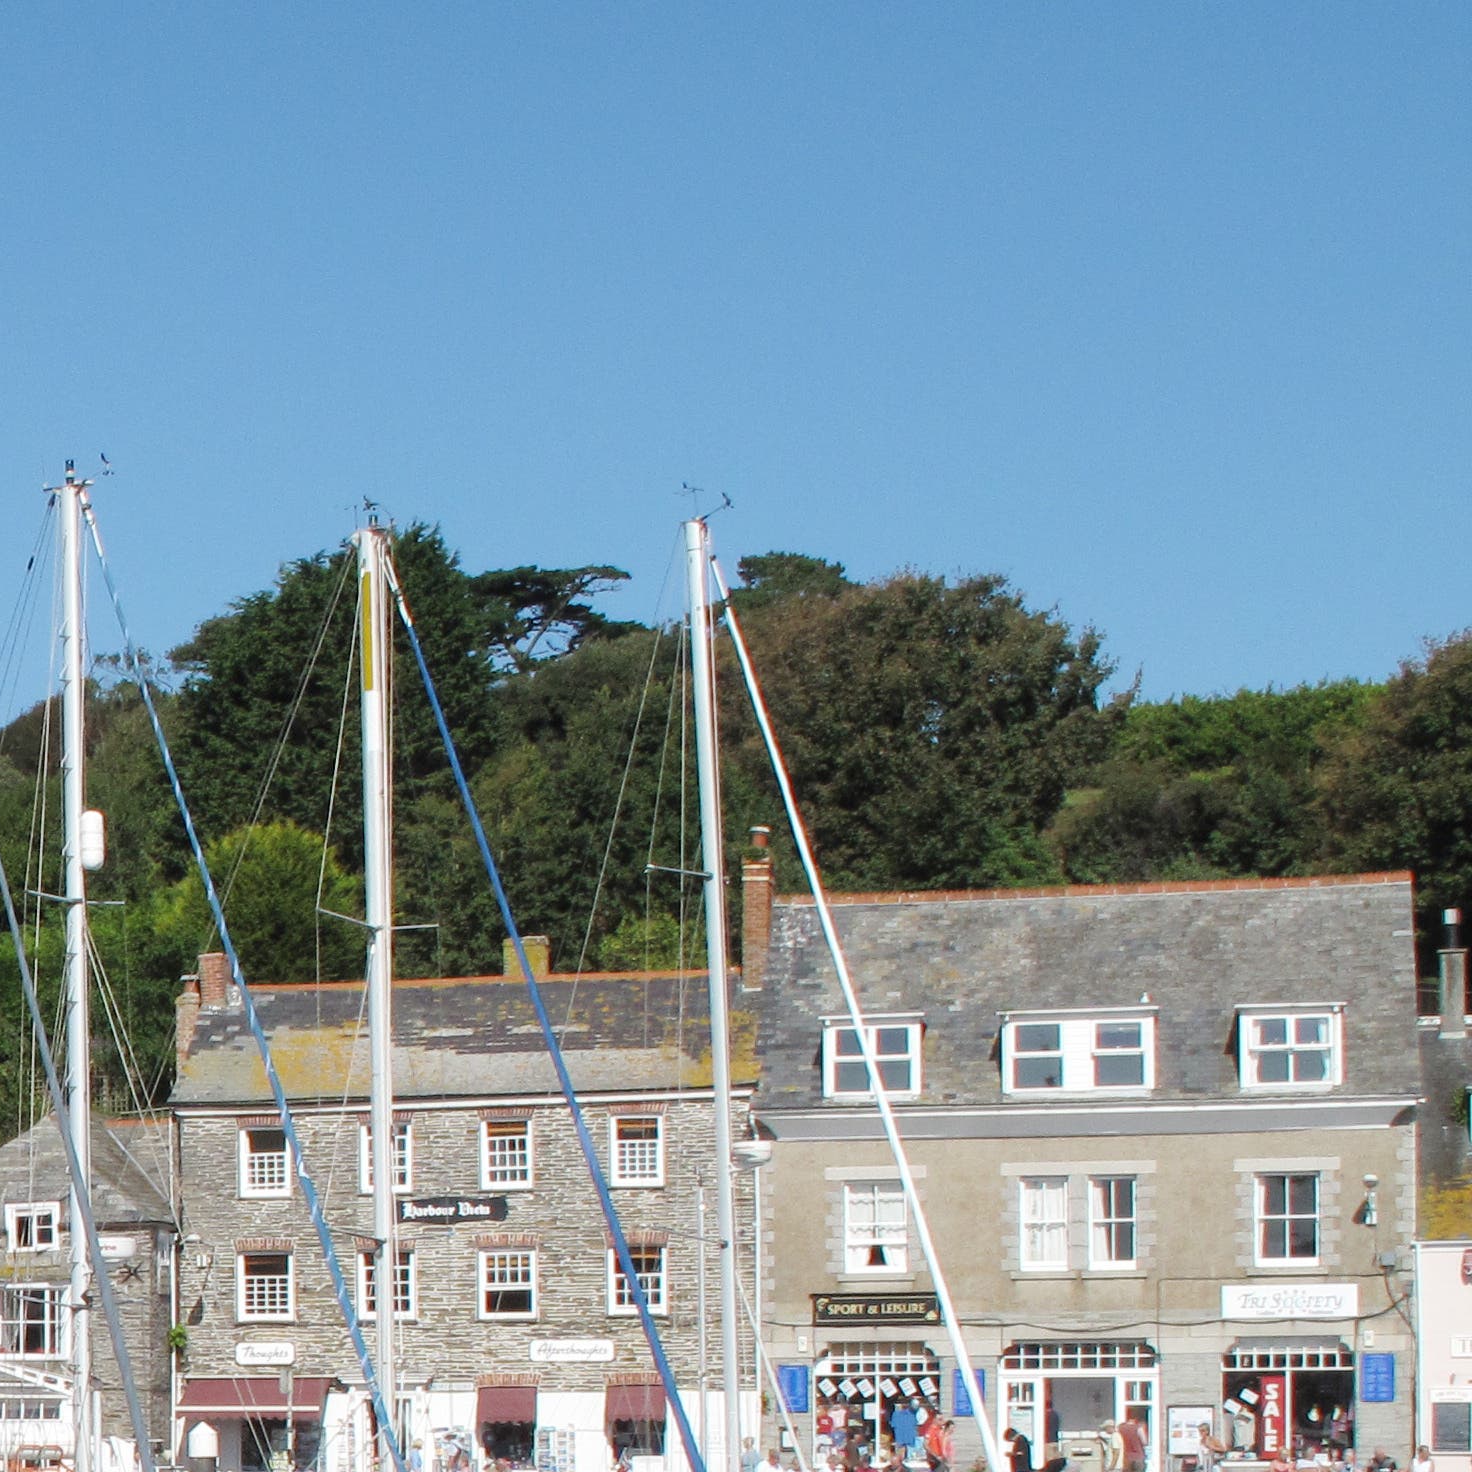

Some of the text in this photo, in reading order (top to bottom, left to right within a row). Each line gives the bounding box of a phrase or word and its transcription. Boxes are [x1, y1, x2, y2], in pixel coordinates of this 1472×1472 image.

[402, 1202, 455, 1219] Harbour
[827, 1304, 865, 1315] SPORT
[880, 1303, 926, 1314] LEISURE
[241, 1346, 289, 1361] Thoughts
[536, 1342, 608, 1359] Afterthoughts
[1263, 1383, 1280, 1452] SALE
